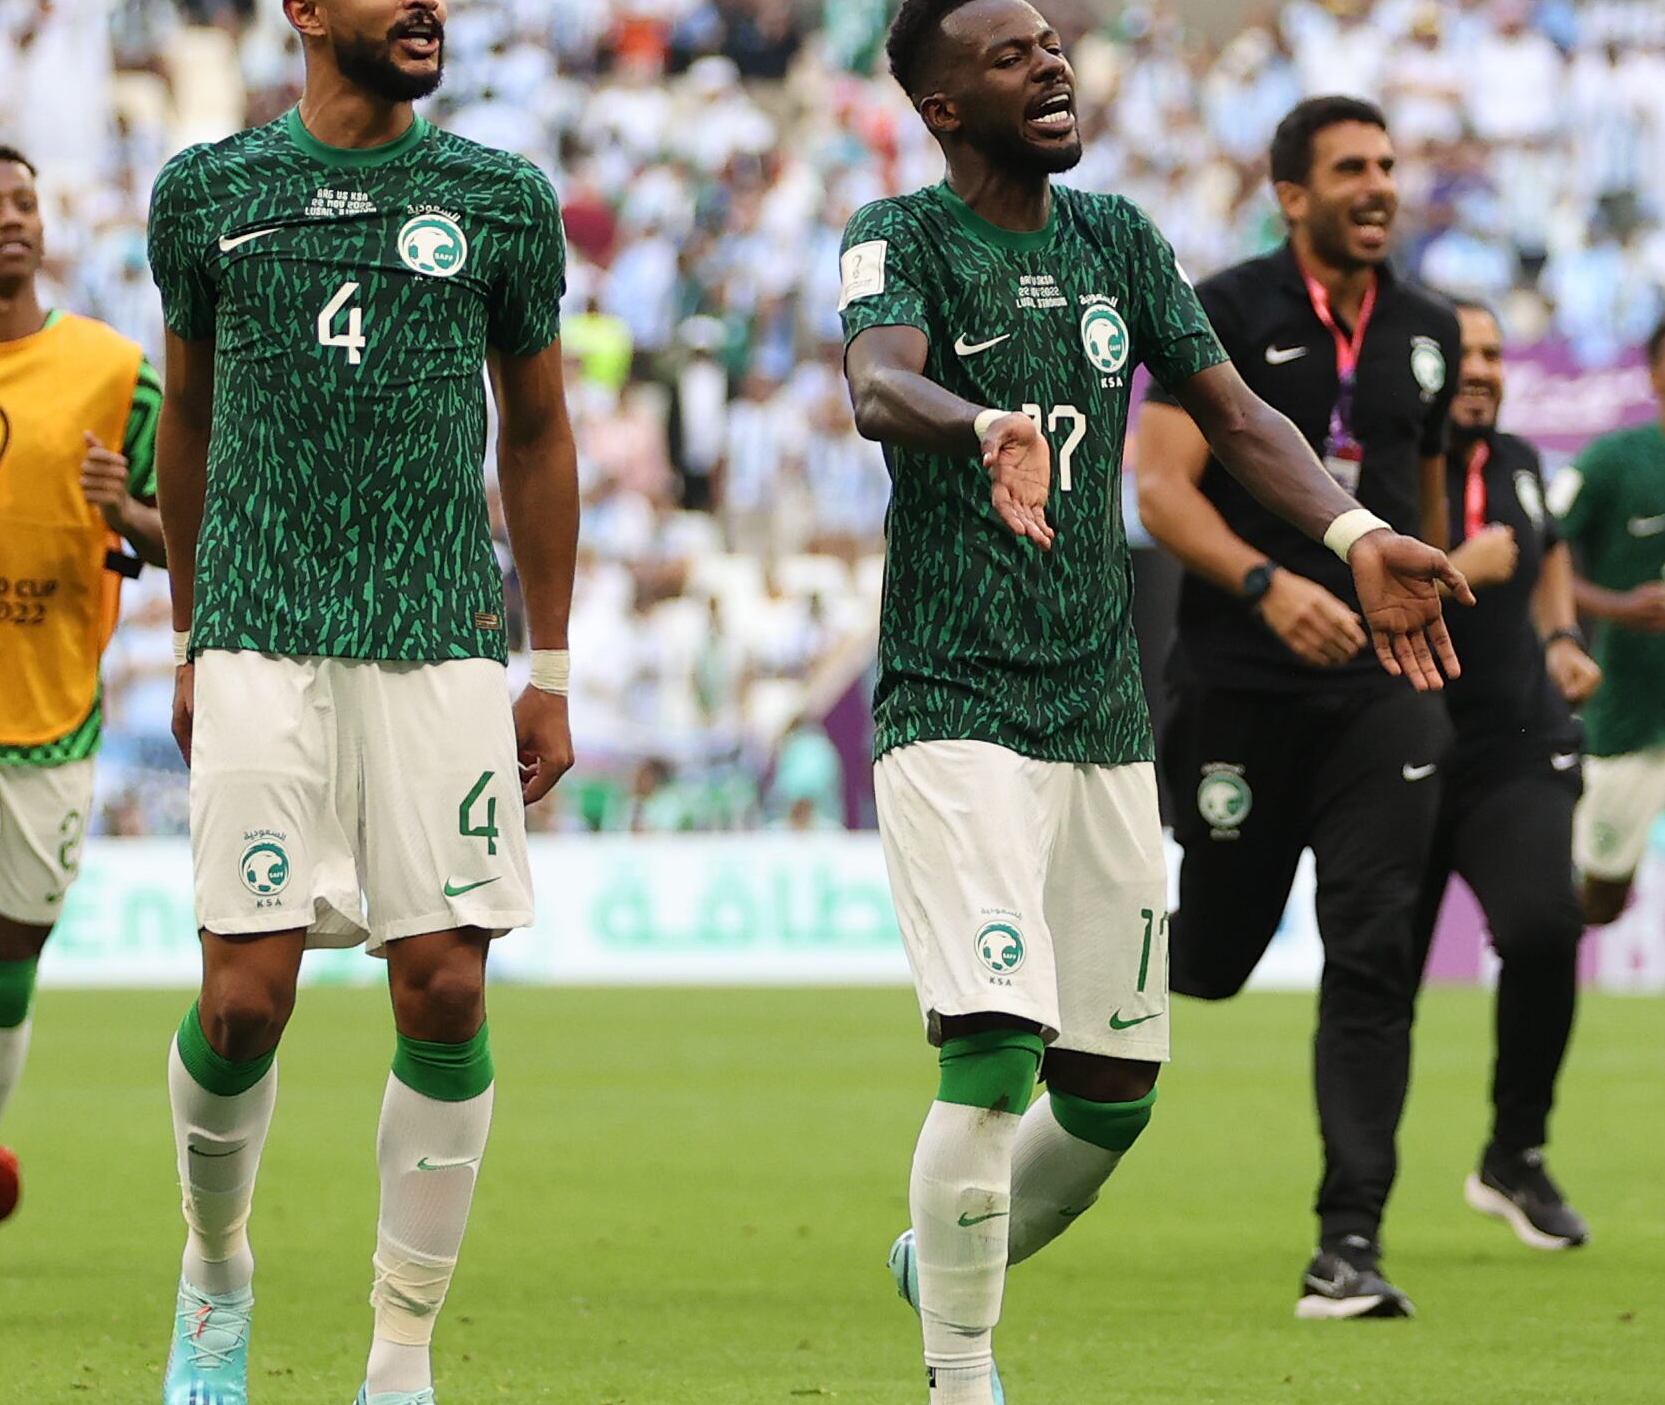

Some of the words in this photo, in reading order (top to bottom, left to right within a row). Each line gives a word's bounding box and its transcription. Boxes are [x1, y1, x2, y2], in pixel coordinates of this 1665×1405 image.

[317, 281, 366, 365] 4
[1101, 377, 1123, 388] KSA
[459, 771, 499, 856] 4
[257, 898, 283, 908] KSA
[1136, 908, 1170, 994] 1
[989, 976, 1012, 987] KSA
